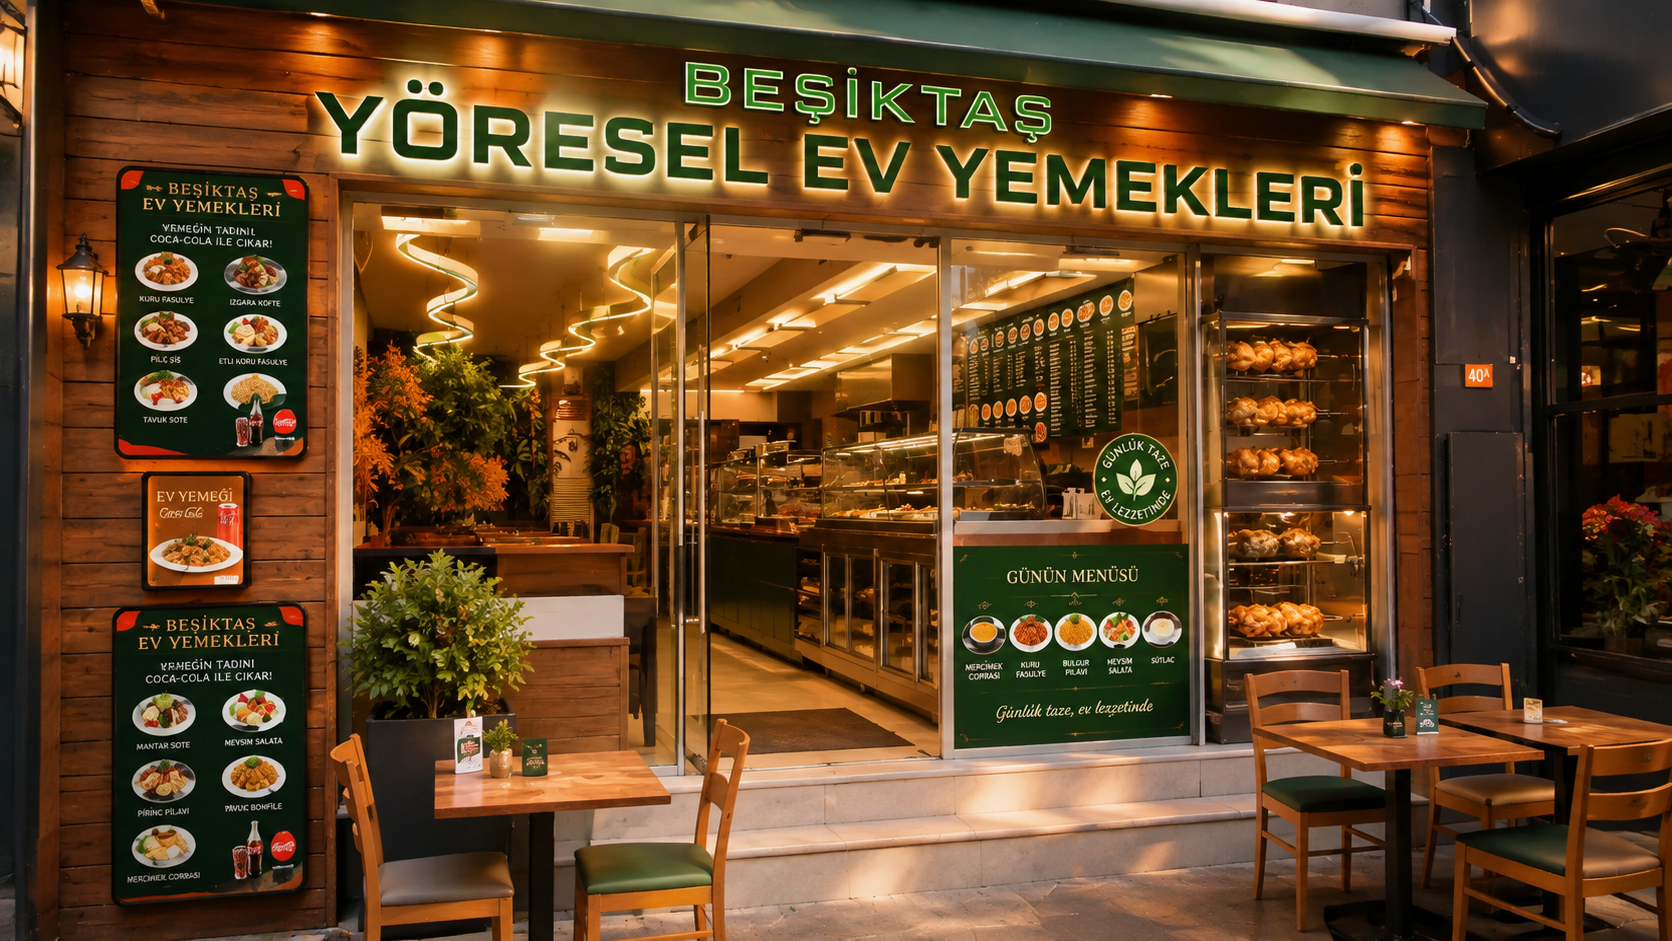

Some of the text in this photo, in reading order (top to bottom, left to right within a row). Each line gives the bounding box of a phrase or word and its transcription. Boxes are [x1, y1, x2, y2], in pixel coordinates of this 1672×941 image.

[683, 60, 1053, 143] BEŞİKTAŞ
[313, 79, 1366, 229] YÖRESEL EV YEMEKLERİ
[168, 180, 258, 202] BEŞİKTAŞ
[143, 197, 281, 217] EV YEMEKLERİ
[149, 234, 213, 246] COCA-COLA
[142, 416, 188, 424] TAVUK SOTE
[156, 487, 233, 503] EV YEMEĞİ
[1006, 565, 1139, 585] GÜNÜN MENÜSÜ
[166, 614, 257, 636] BEŞİKTAŞ
[138, 630, 280, 650] EV YEMEKLERİ
[145, 672, 211, 684] COCA-COLA
[1045, 704, 1074, 718] taze,
[1077, 705, 1092, 715] ev
[136, 740, 191, 751] MANTAR SOTE
[254, 737, 284, 746] SALATA
